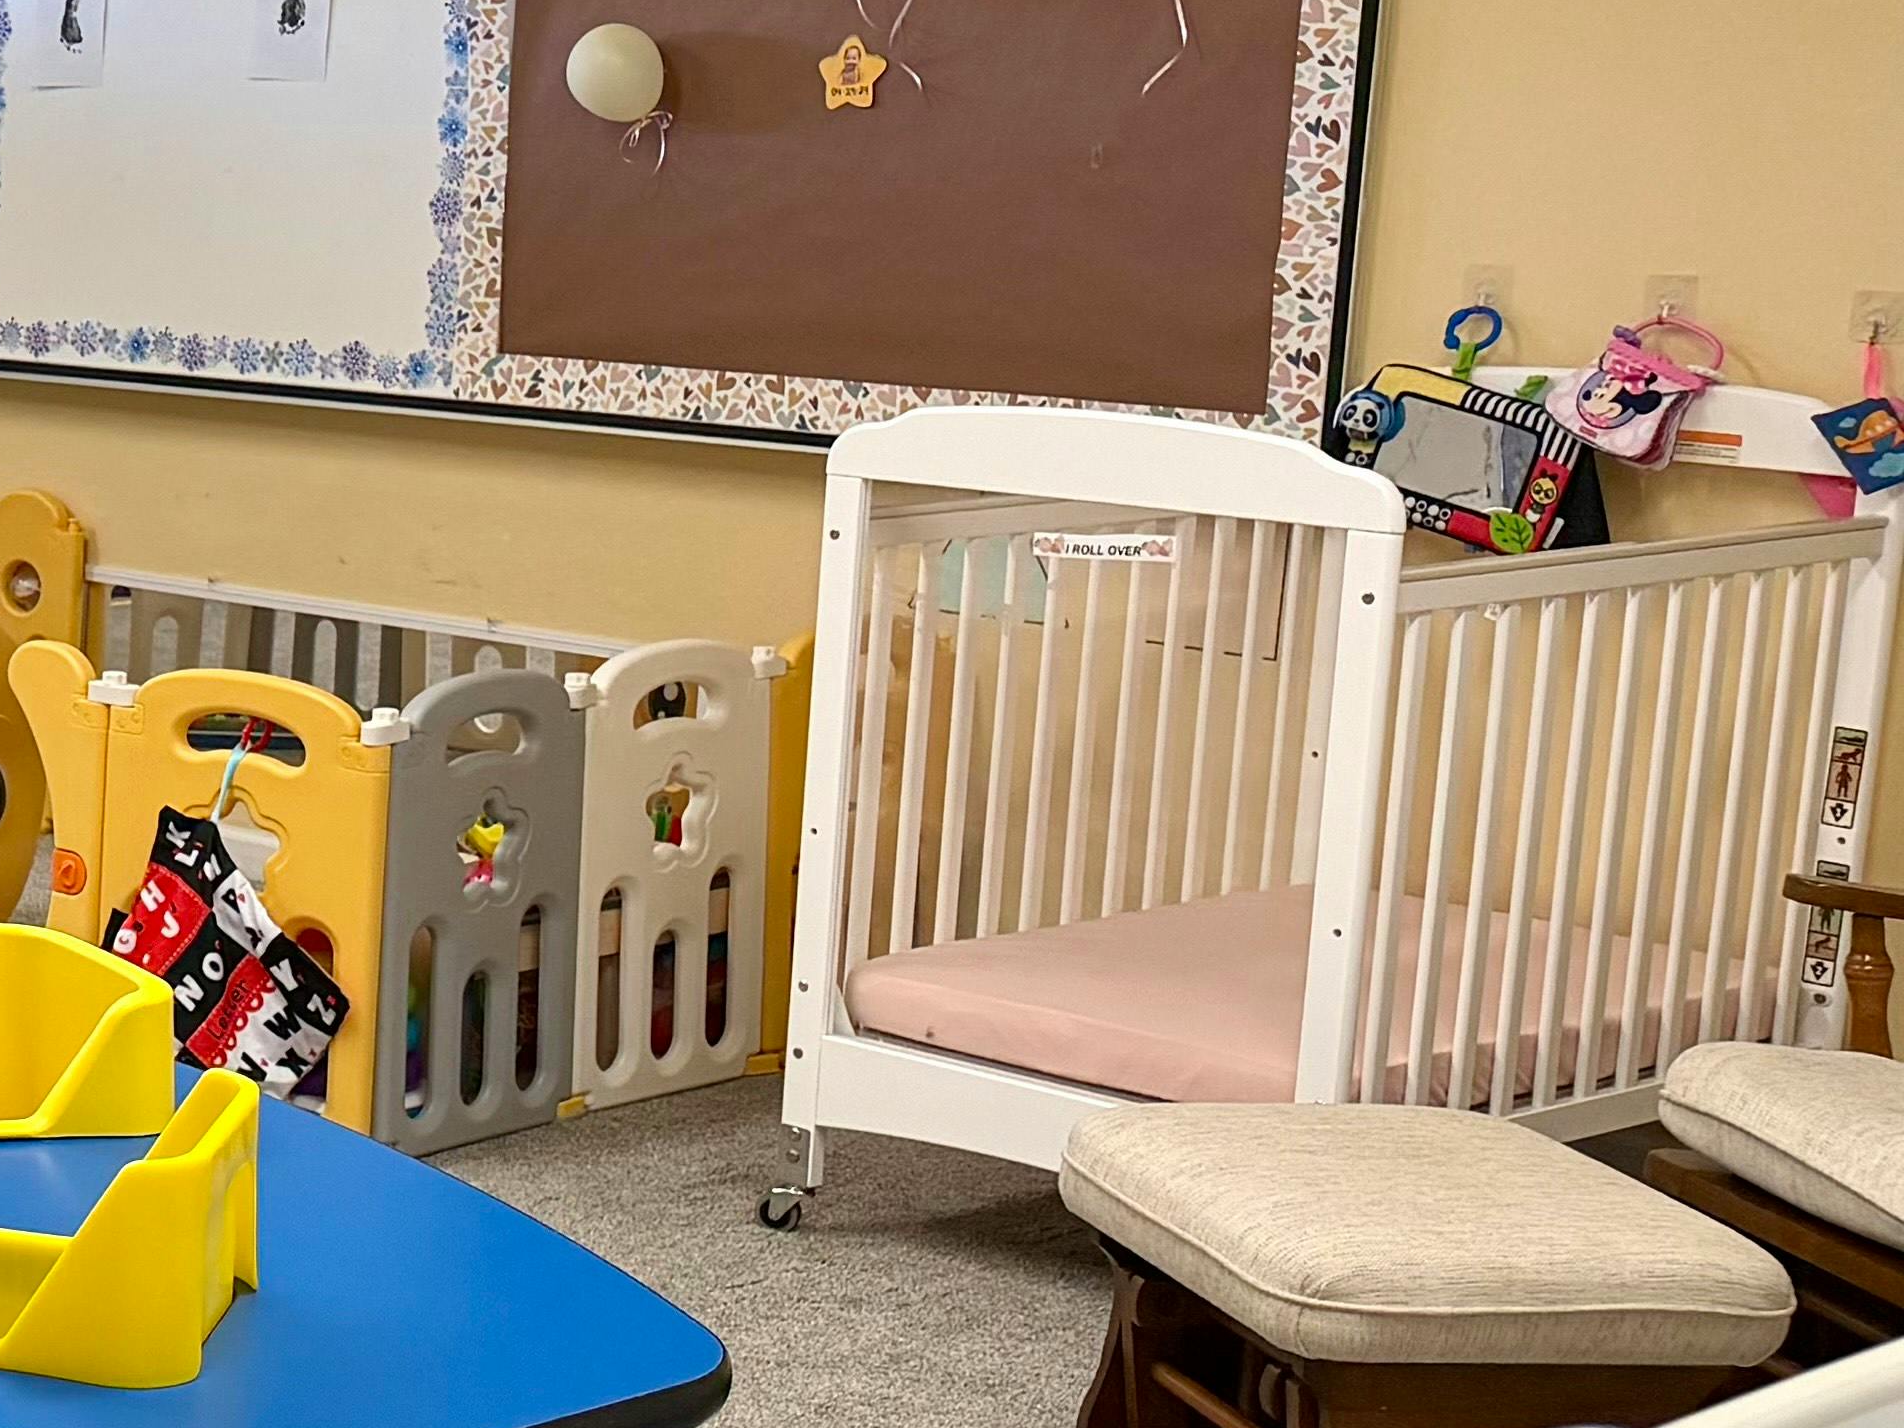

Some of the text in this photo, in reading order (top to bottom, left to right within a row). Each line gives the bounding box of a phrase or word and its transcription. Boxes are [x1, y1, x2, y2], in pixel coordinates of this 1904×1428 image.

[1072, 544, 1105, 556] ROLL
[1107, 544, 1143, 557] OVER
[166, 821, 191, 849] K
[174, 849, 199, 867] L
[140, 879, 166, 912] H
[160, 910, 181, 938] J
[202, 951, 224, 982] O
[173, 974, 204, 1012] N
[263, 1003, 302, 1041] W
[307, 993, 337, 1027] Z
